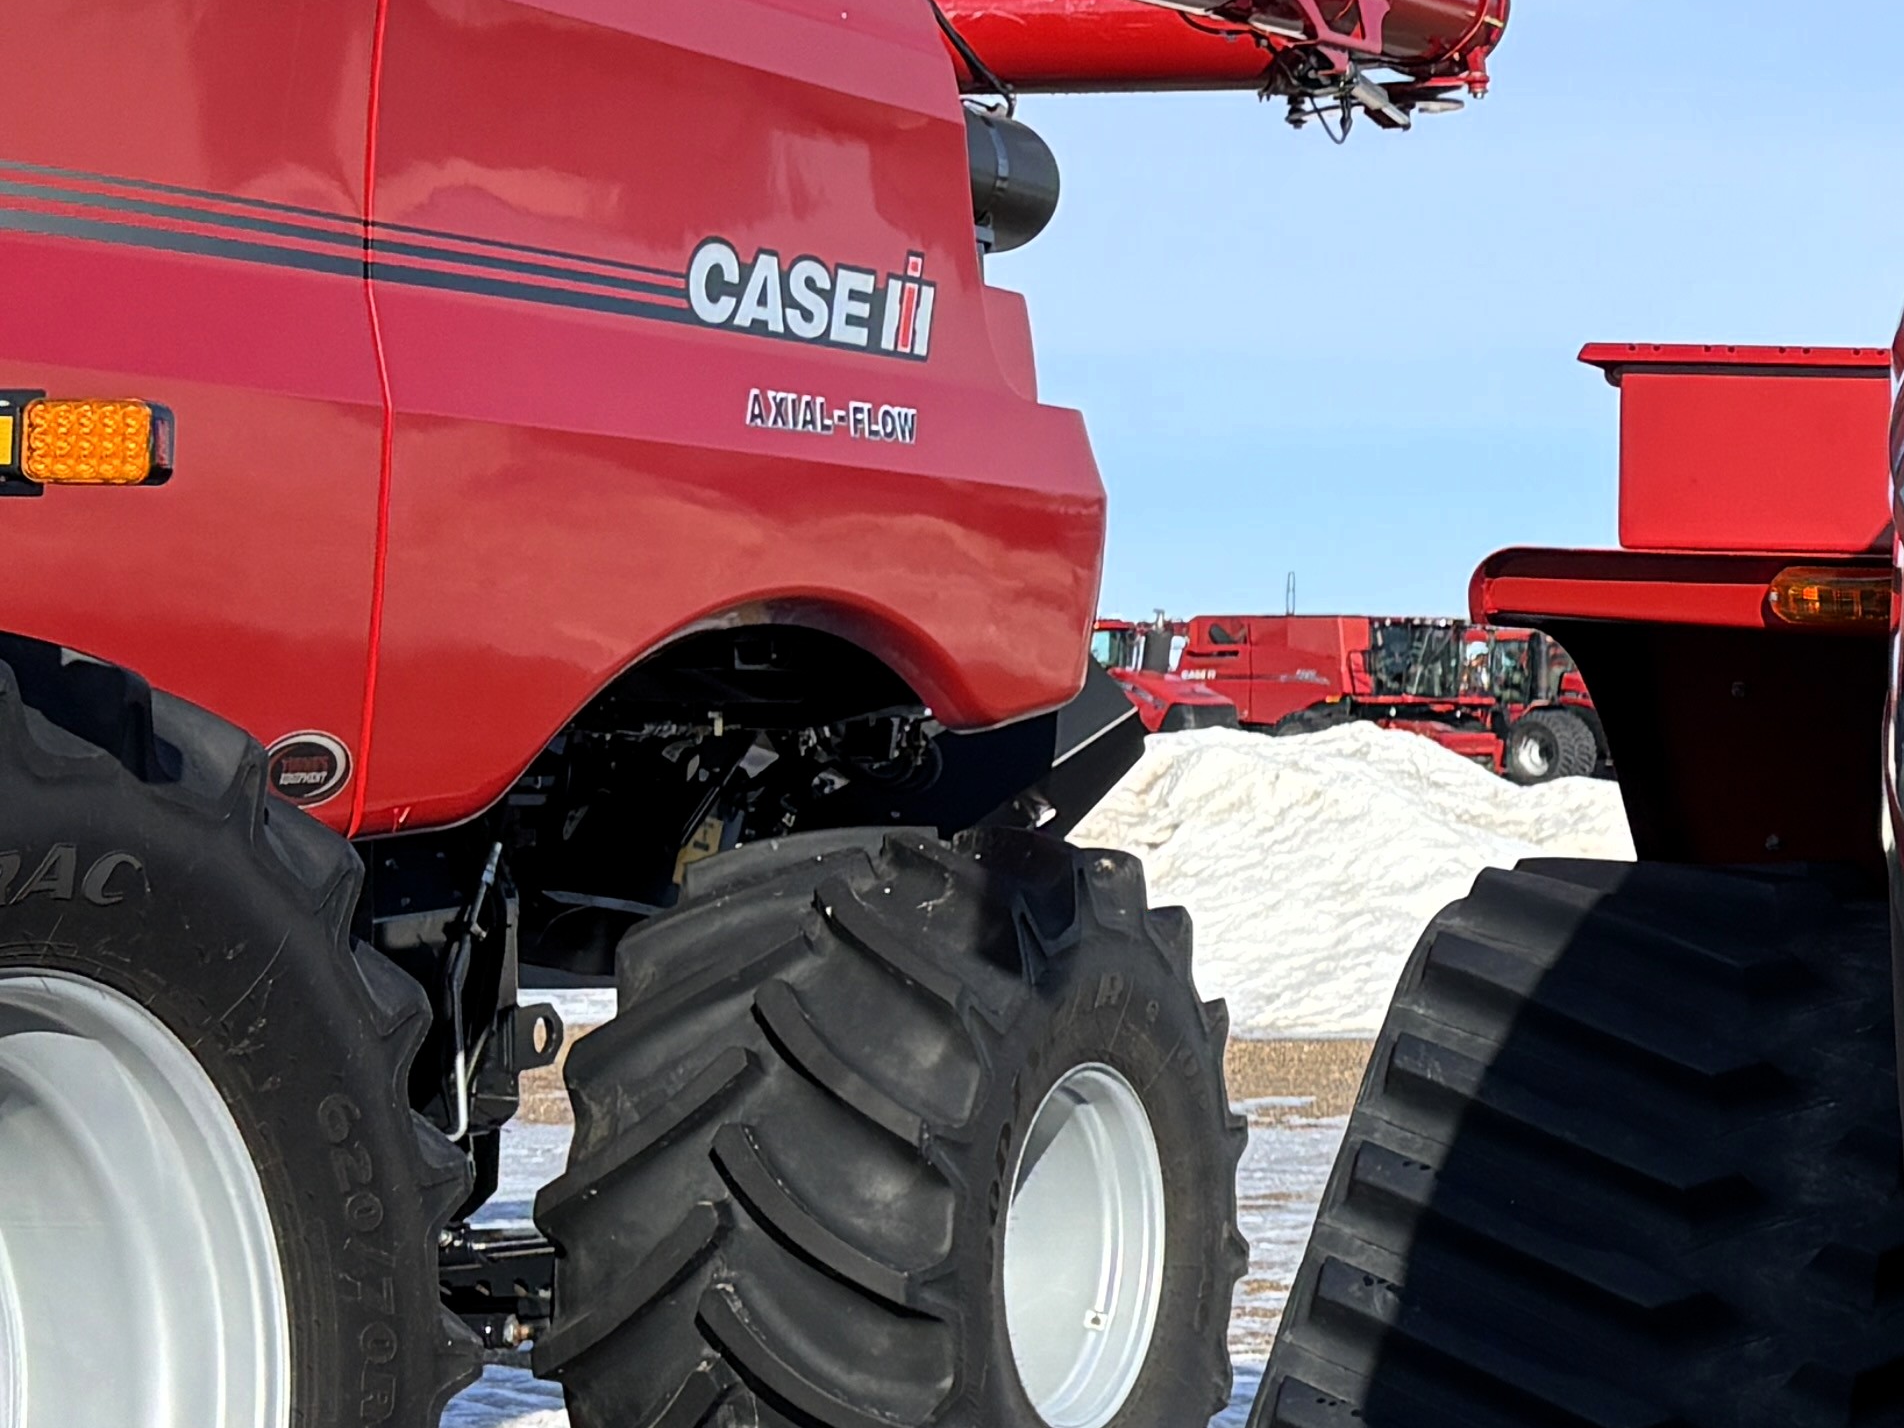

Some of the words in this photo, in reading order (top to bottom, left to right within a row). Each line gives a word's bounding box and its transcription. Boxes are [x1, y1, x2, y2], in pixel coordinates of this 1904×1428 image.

[687, 240, 877, 348] CASE
[880, 253, 936, 357] IH
[746, 387, 917, 445] AXIAL-FLOW
